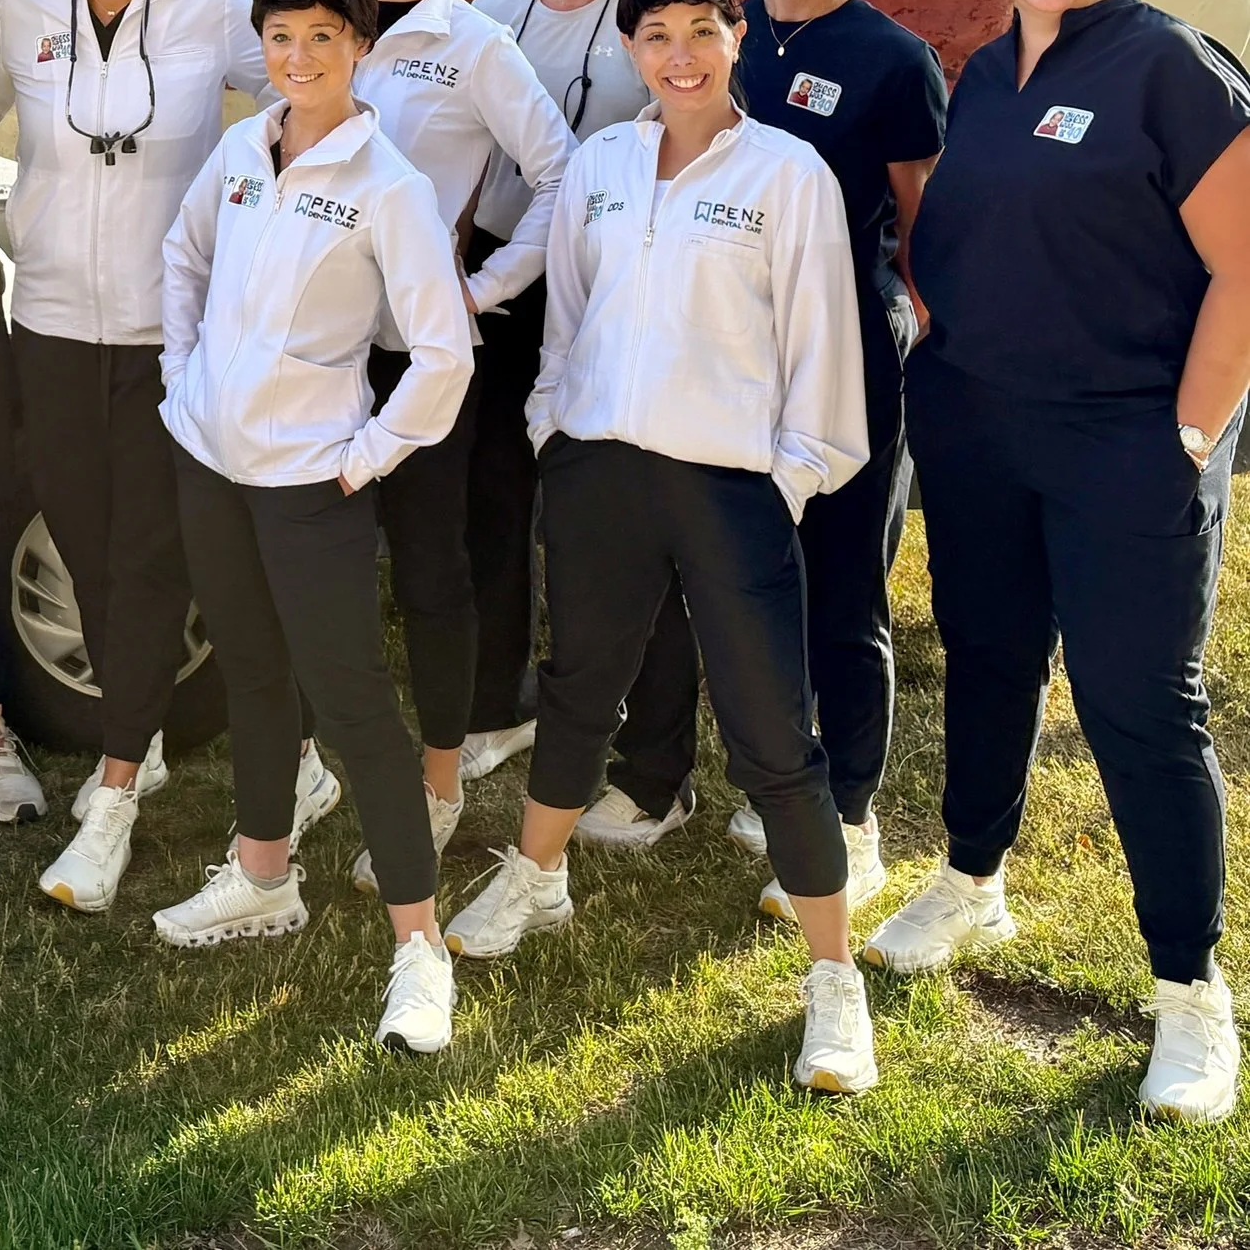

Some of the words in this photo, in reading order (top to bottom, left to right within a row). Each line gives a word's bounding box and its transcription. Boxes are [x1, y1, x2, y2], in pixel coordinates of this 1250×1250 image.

[406, 72, 433, 82] DENTAL
[408, 60, 460, 81] PENZ
[307, 210, 333, 223] DENTAL
[310, 196, 360, 223] PENZ
[712, 203, 765, 226] PENZ
[711, 217, 742, 230] DENTAL
